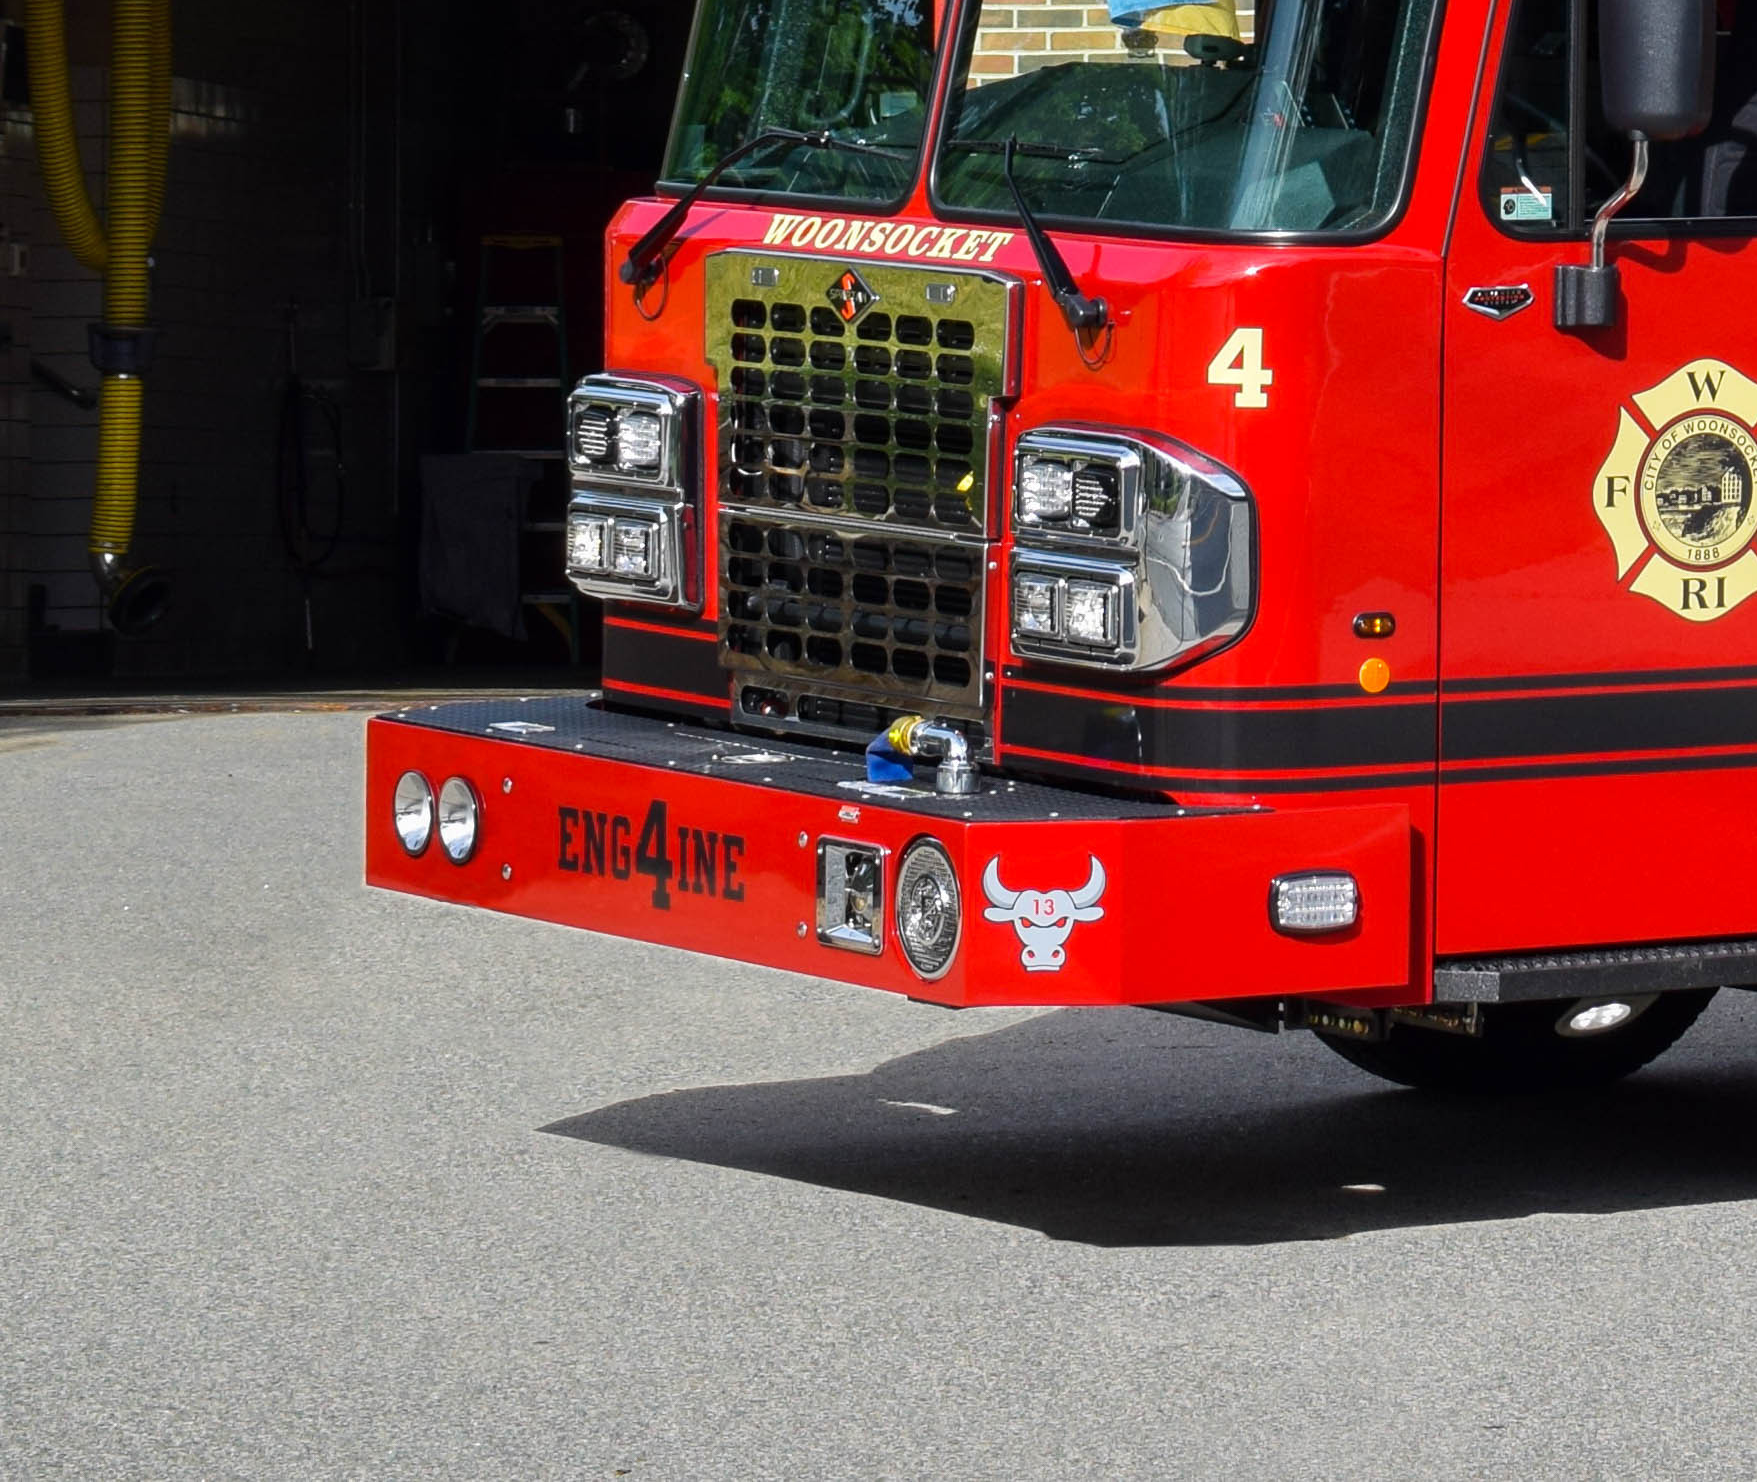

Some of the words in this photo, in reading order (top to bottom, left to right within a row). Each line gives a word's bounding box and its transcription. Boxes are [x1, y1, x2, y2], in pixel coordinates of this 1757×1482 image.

[762, 214, 1015, 262] WOONSOCKET
[1206, 327, 1273, 408] 4
[1686, 370, 1726, 403] W
[1644, 455, 1662, 491] CITY
[1661, 432, 1679, 450] OF
[1604, 475, 1631, 508] F
[1687, 547, 1720, 560] 1888
[1680, 576, 1729, 610] RI
[1033, 898, 1055, 916] 13
